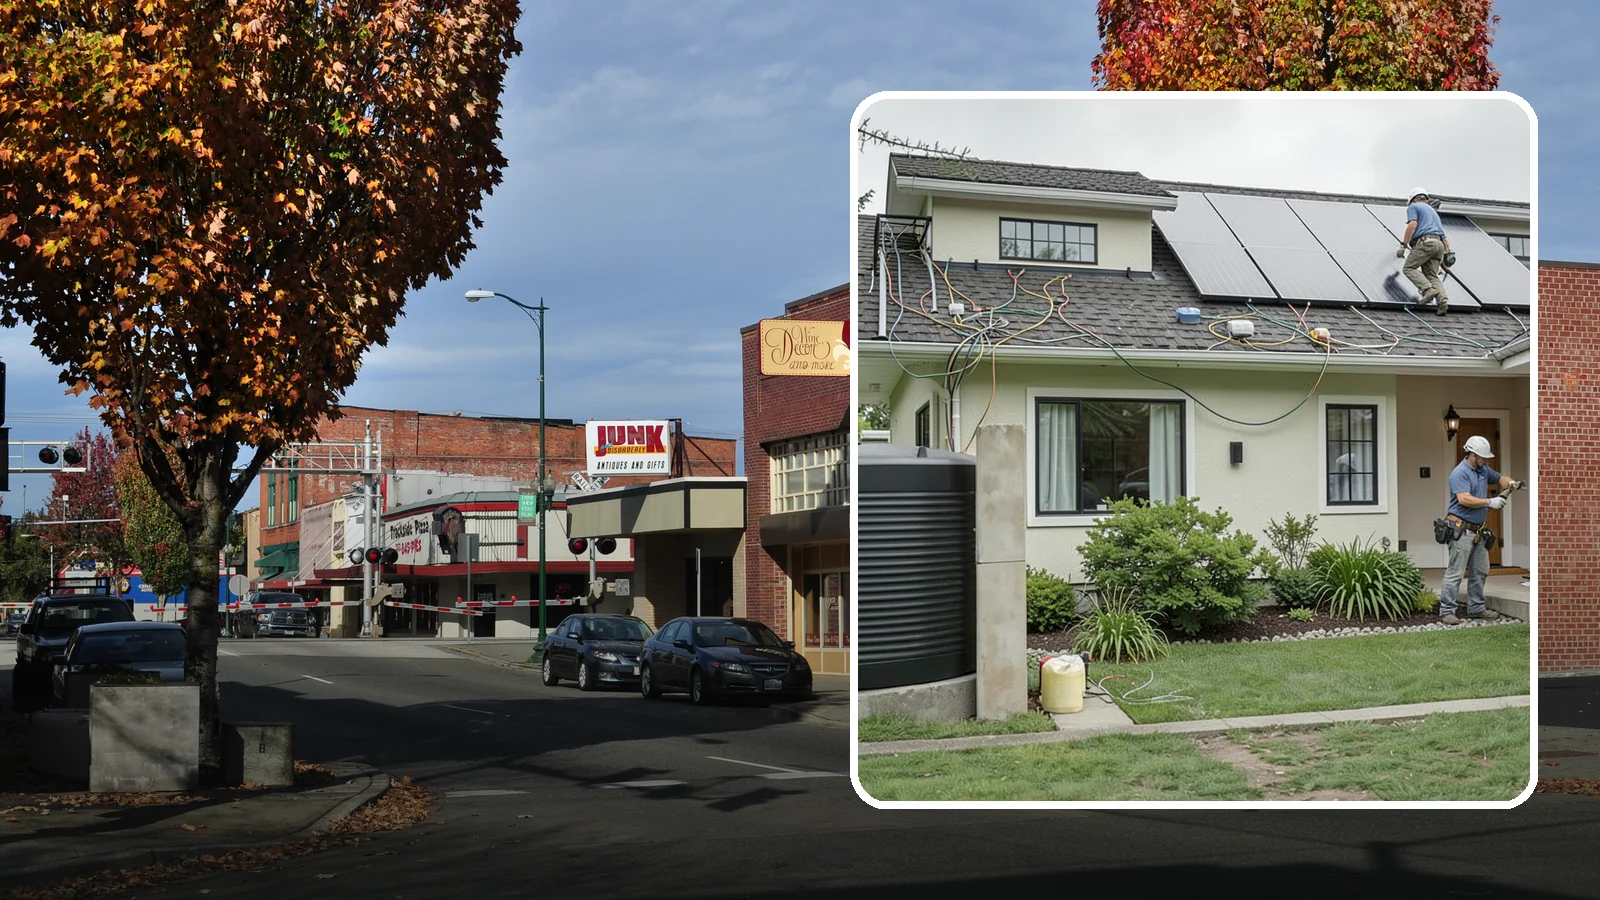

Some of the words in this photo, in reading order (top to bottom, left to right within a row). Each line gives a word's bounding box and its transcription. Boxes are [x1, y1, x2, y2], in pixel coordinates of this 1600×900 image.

[596, 425, 665, 457] JUNK
[608, 446, 646, 454] DISORDERLY
[597, 461, 628, 470] ANTIQUES
[631, 461, 644, 470] AND
[647, 460, 666, 469] GIFTS
[390, 521, 413, 539] Trackside
[414, 519, 429, 535] Pizza
